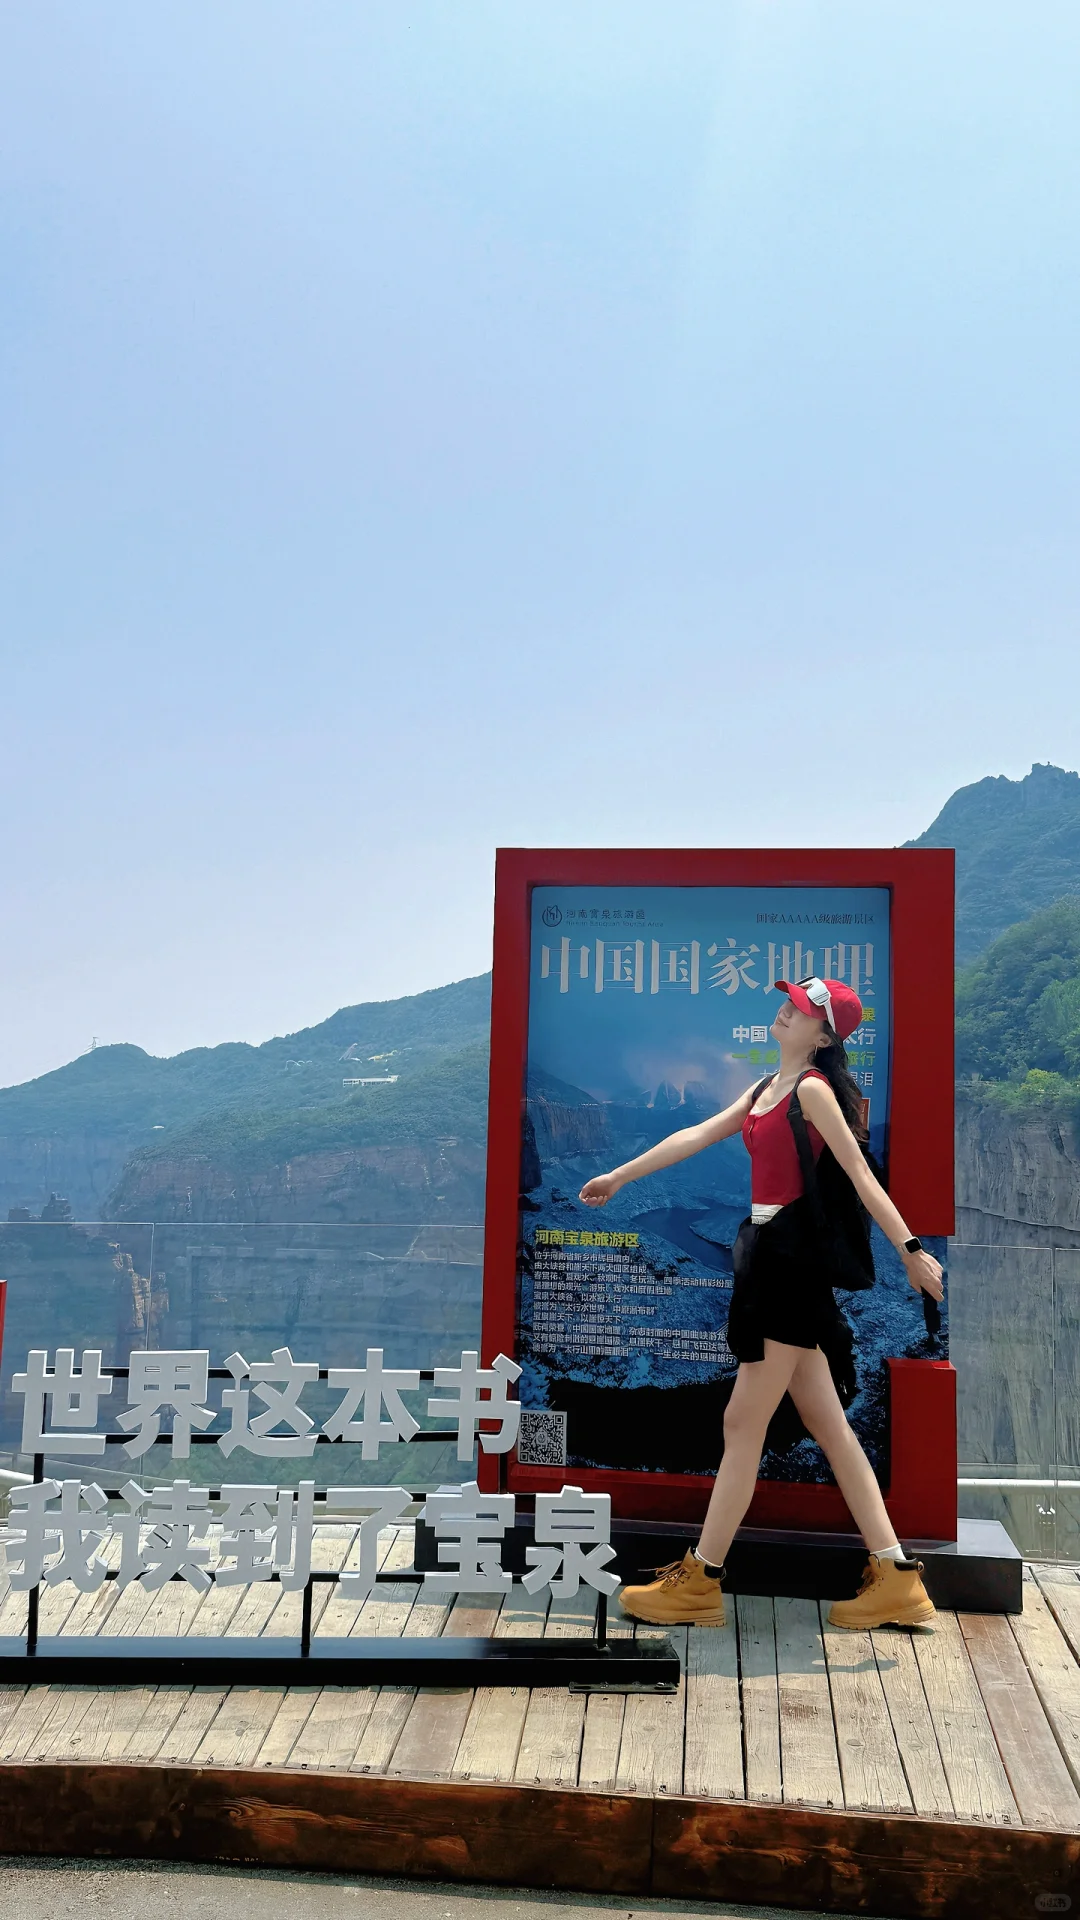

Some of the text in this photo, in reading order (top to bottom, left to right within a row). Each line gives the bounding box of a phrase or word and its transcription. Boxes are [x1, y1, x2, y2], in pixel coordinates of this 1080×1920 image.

[541, 936, 876, 997] 中国国家地理
[535, 1229, 640, 1248] 河南宝泉旅游区
[11, 1347, 524, 1462] 世界这本书
[4, 1479, 622, 1599] 我读到了宝泉
